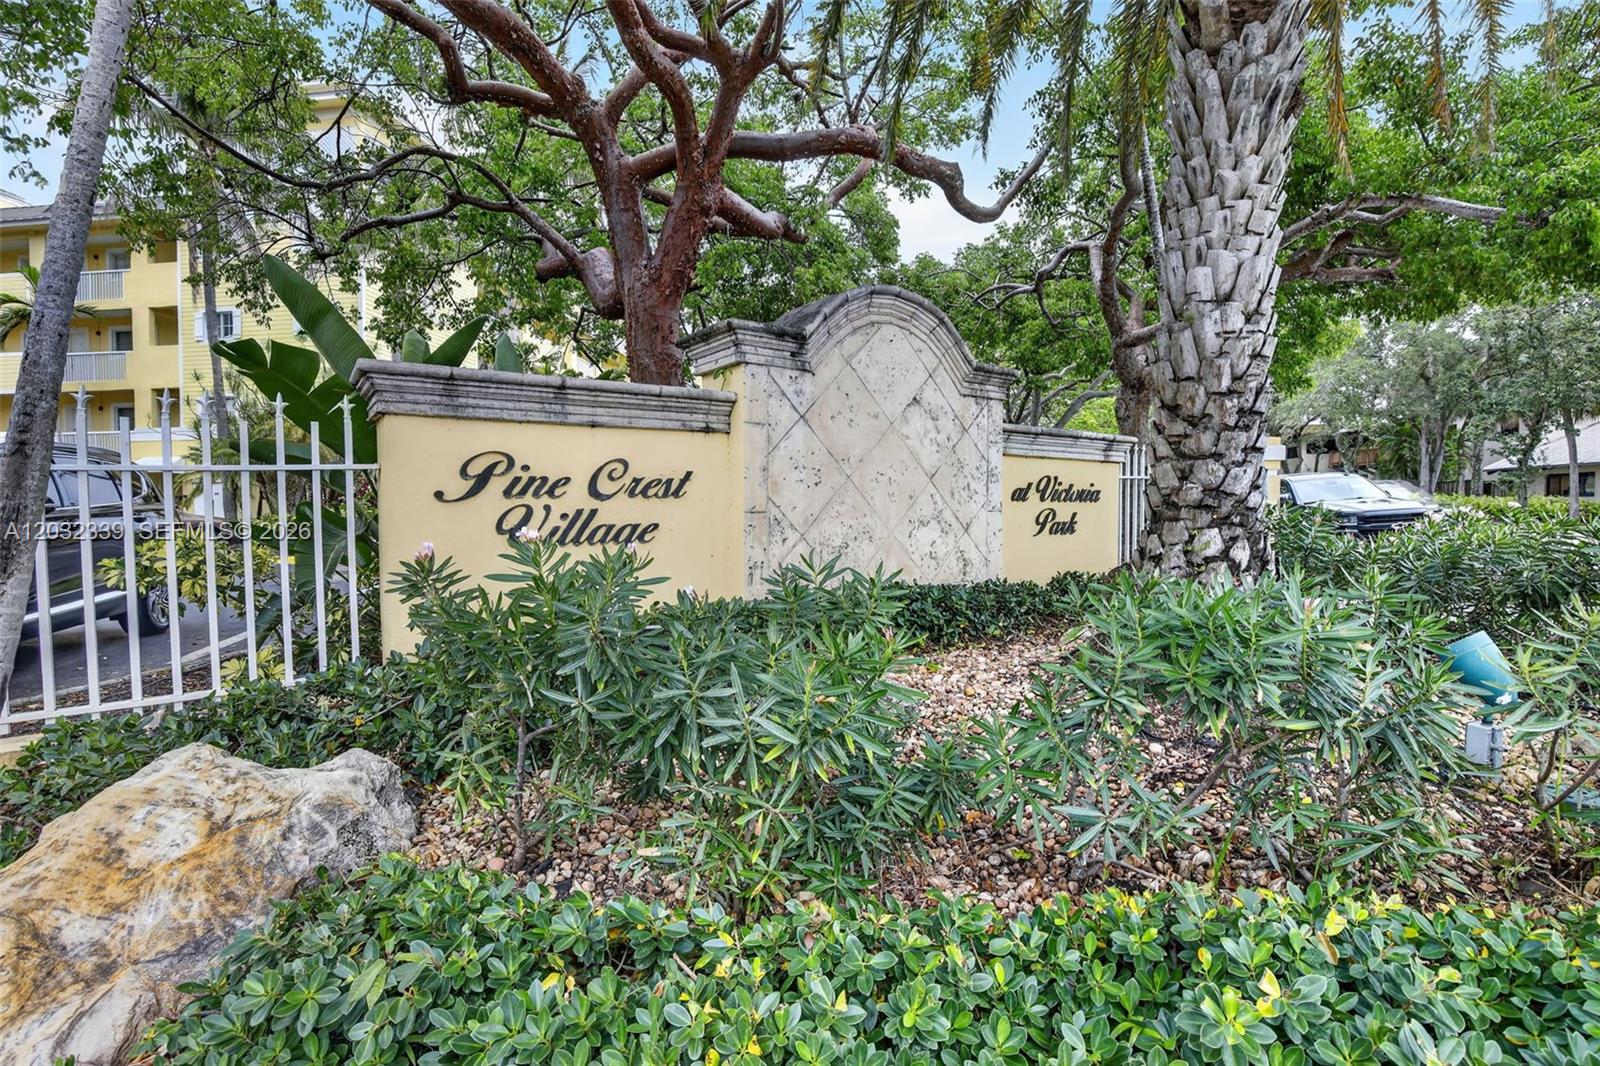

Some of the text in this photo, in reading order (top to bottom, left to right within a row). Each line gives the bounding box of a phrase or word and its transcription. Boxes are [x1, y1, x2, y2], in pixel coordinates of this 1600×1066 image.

[433, 450, 694, 503] Pine Crest
[1010, 474, 1101, 503] at Victoria
[495, 503, 660, 548] Village
[1032, 507, 1078, 537] Park
